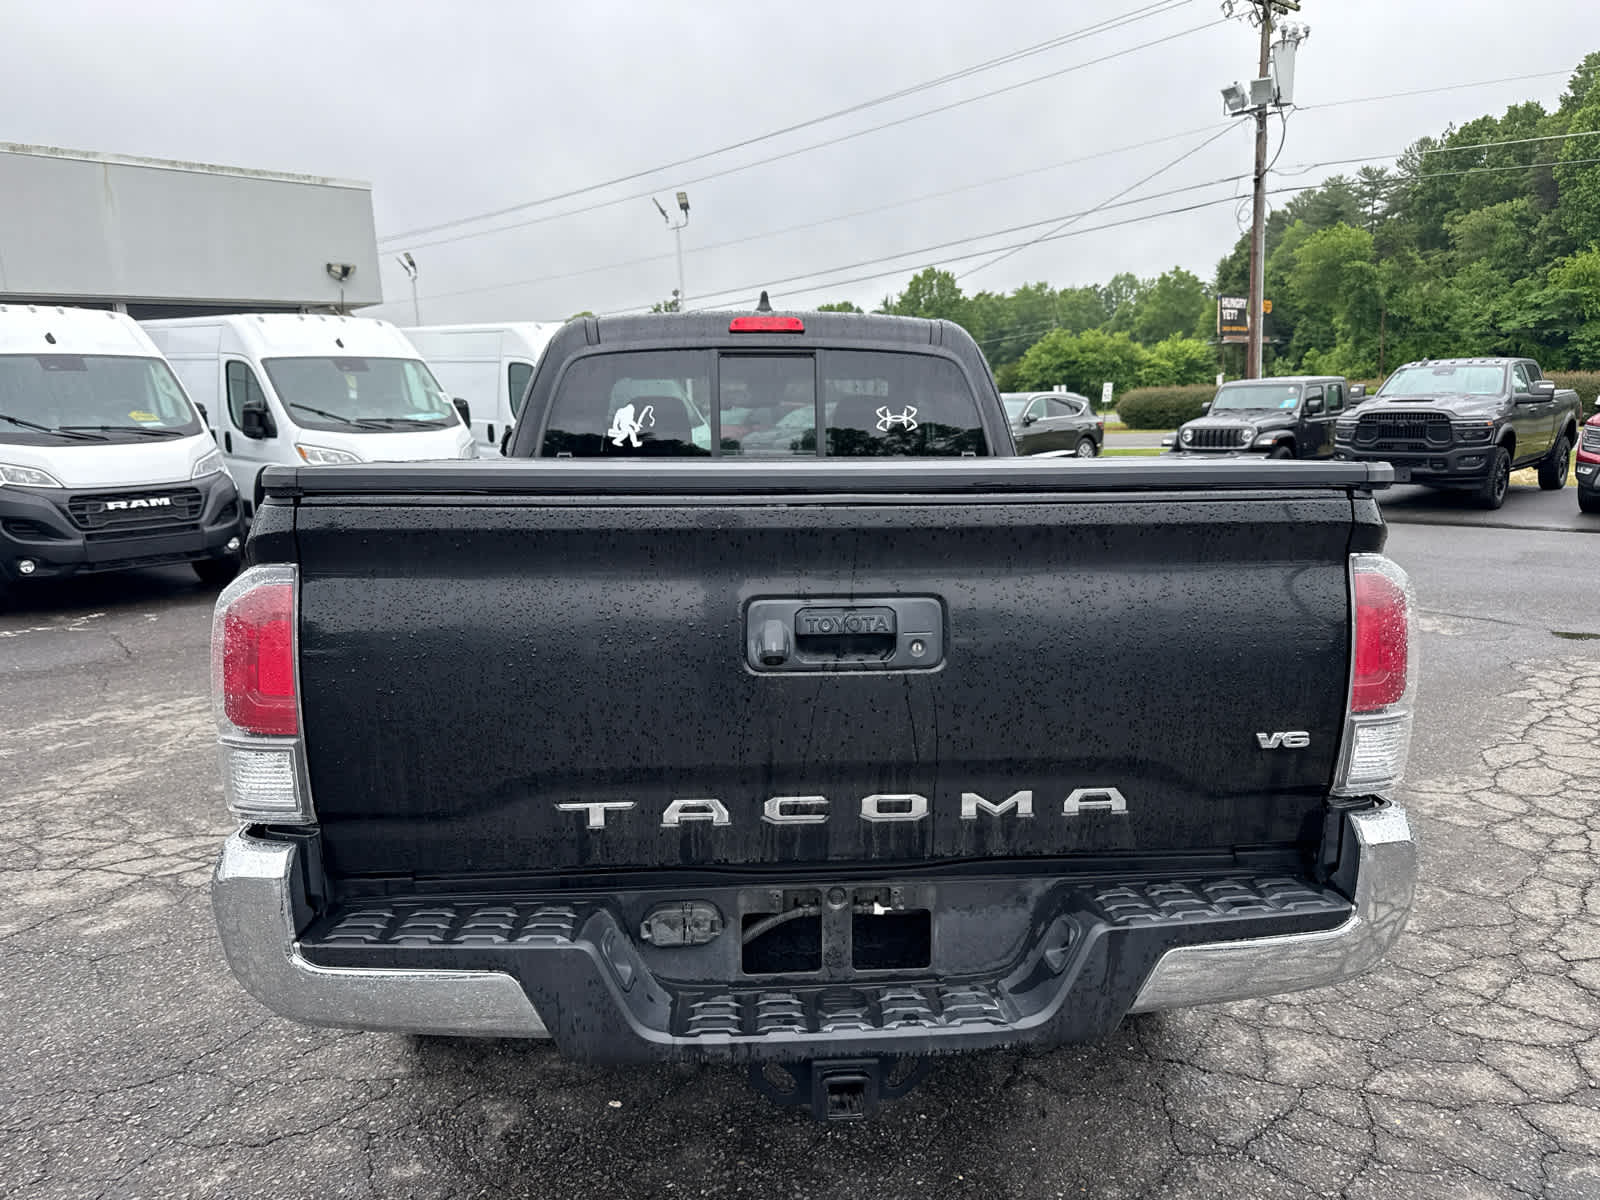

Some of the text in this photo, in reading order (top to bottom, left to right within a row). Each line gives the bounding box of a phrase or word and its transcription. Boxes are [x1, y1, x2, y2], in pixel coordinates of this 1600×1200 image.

[106, 497, 171, 510] RAM
[805, 615, 889, 633] TOYOTA
[1256, 731, 1310, 749] V6
[554, 786, 1129, 830] TACOMA
